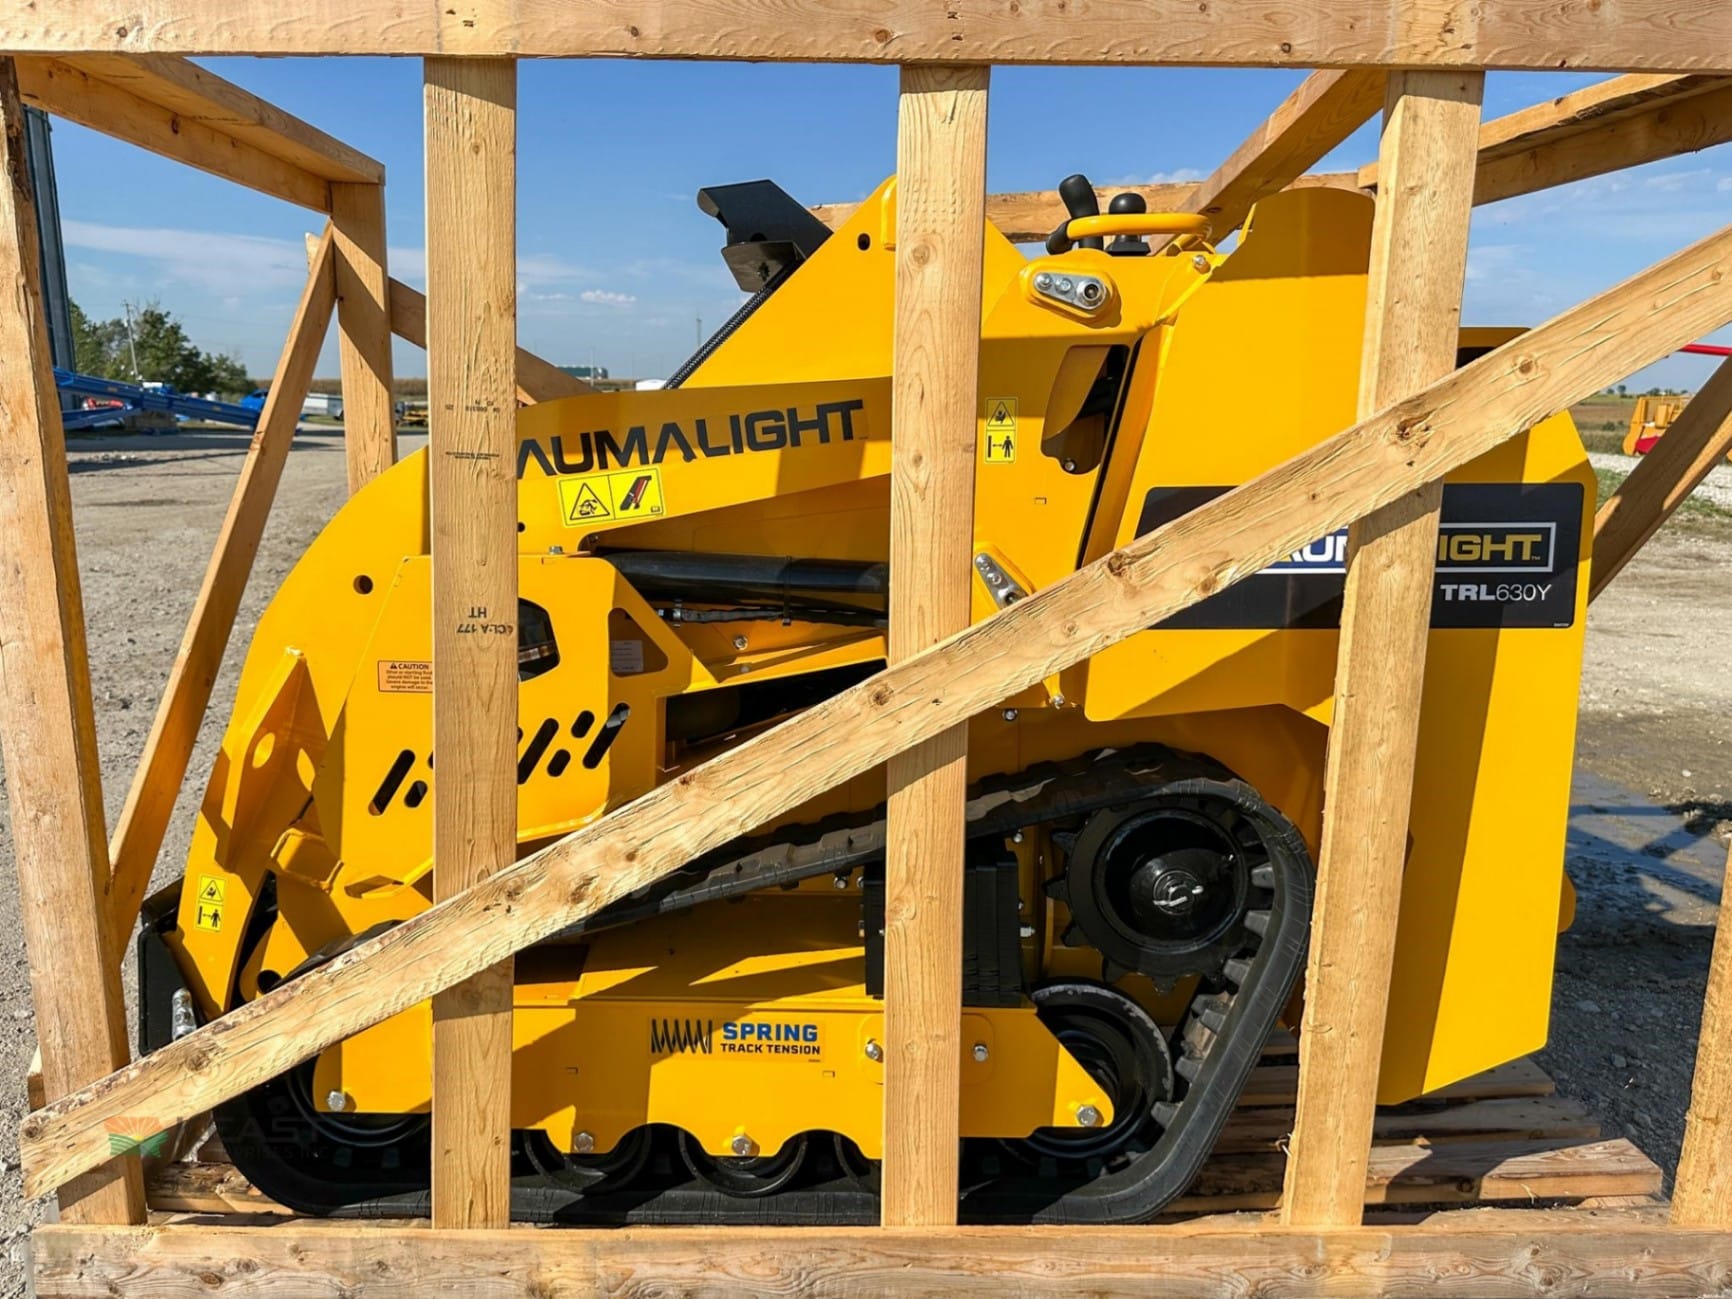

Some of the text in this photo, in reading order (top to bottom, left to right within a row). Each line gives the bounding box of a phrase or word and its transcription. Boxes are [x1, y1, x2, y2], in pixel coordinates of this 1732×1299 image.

[516, 399, 864, 480] AUMALIGHT
[722, 1022, 818, 1042] SPRING
[720, 1043, 821, 1055] TRACK TENSION
